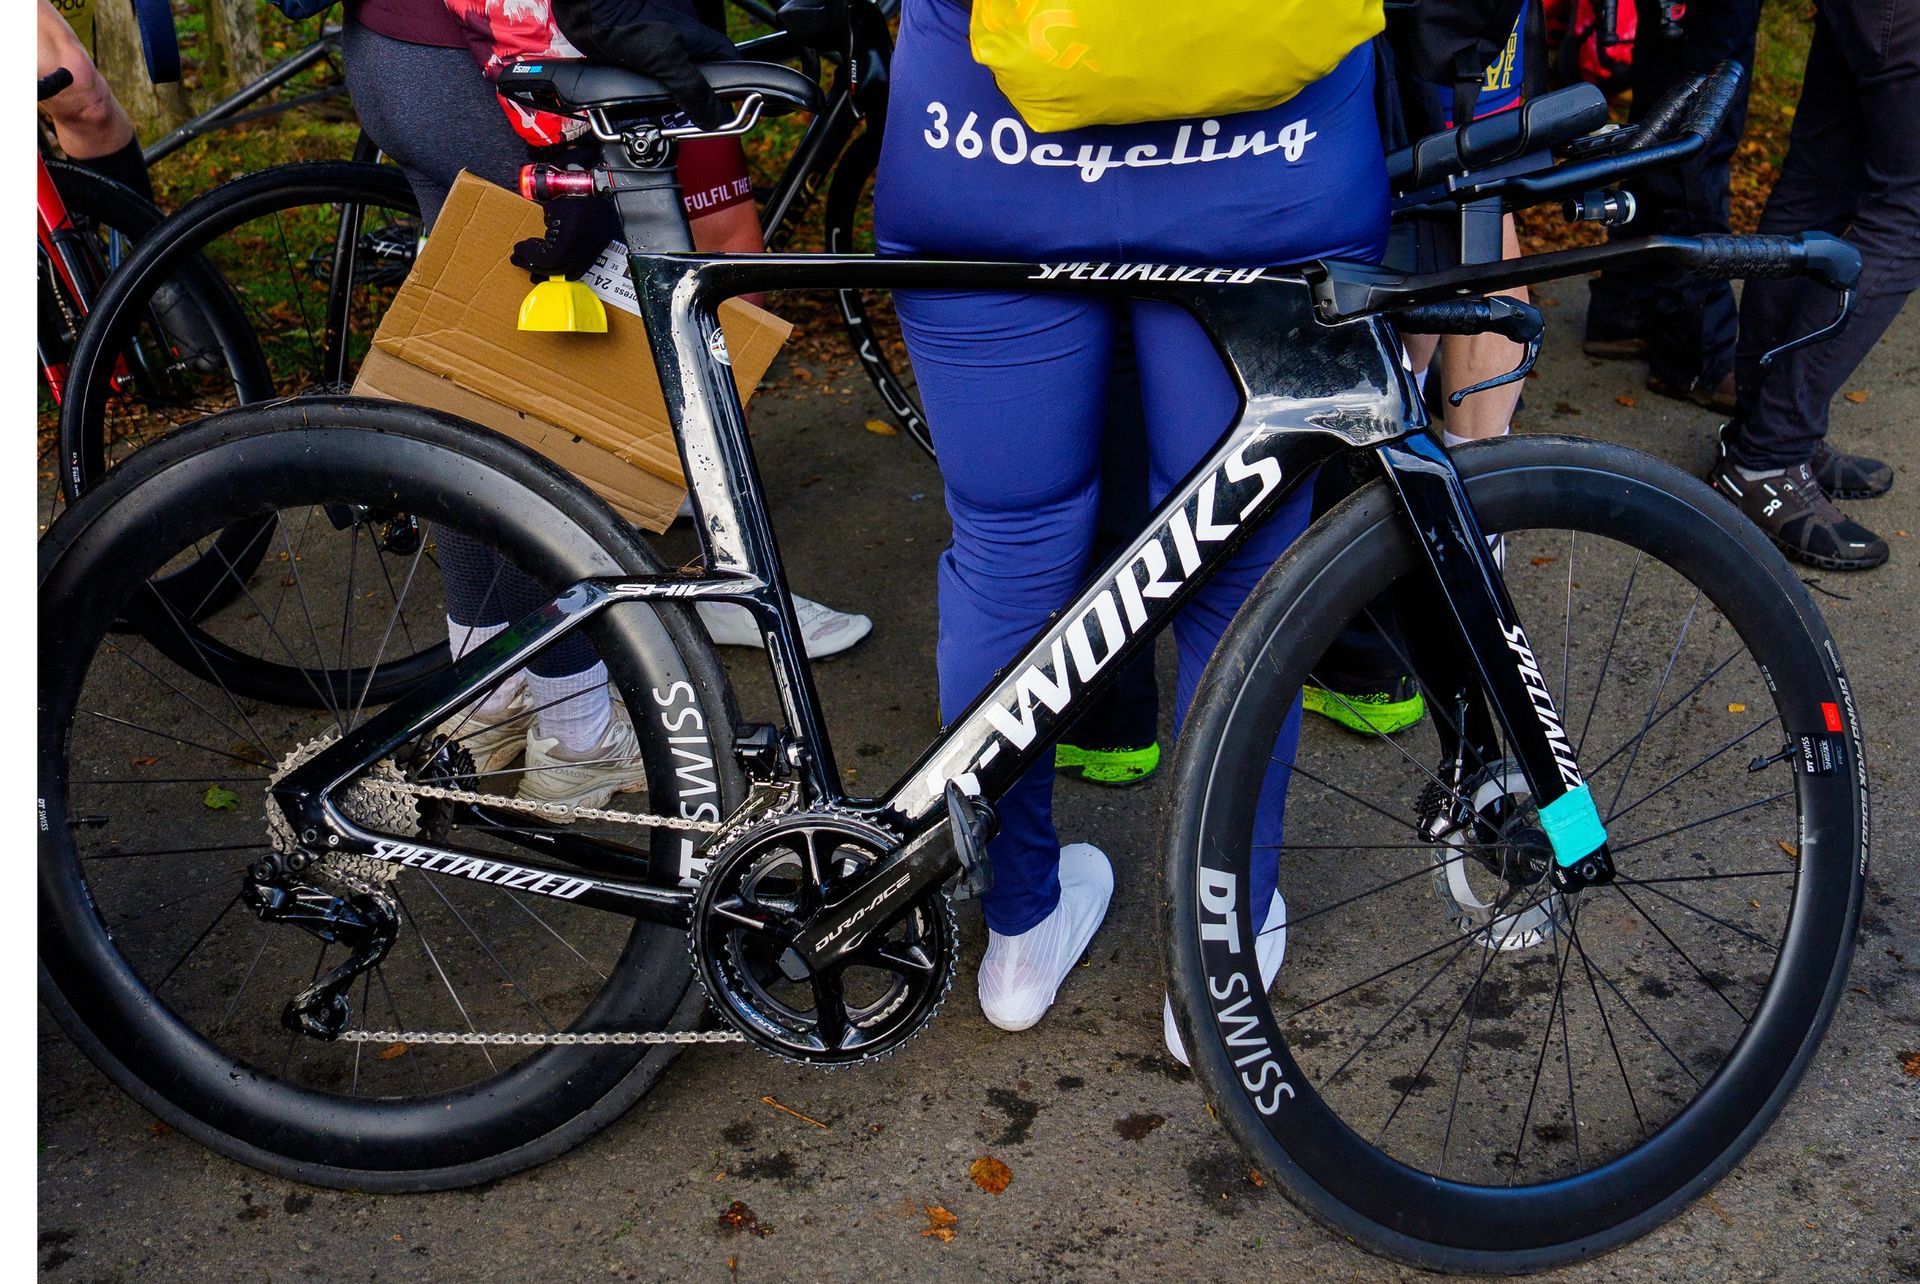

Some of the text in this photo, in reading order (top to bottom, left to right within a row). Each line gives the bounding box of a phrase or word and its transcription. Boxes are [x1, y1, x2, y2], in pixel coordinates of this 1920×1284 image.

[924, 101, 1317, 183] 360cycling
[684, 177, 750, 212] FULFIL THE
[594, 274, 613, 290] 24
[1028, 261, 1266, 284] SPECIALIZED
[615, 584, 724, 597] SHIV
[926, 422, 1282, 797] S-WORKS
[1497, 617, 1585, 792] SPECIALIZ
[1838, 677, 1861, 740] GRAND
[1854, 740, 1867, 787] PRIX
[652, 680, 720, 888] T SWISS
[1801, 736, 1815, 773] DT SWISS
[38, 798, 49, 831] DT SWISS
[363, 841, 594, 900] SPECIALIZED
[814, 872, 912, 953] DURA-ACE
[1199, 866, 1296, 1116] DT SWISS
